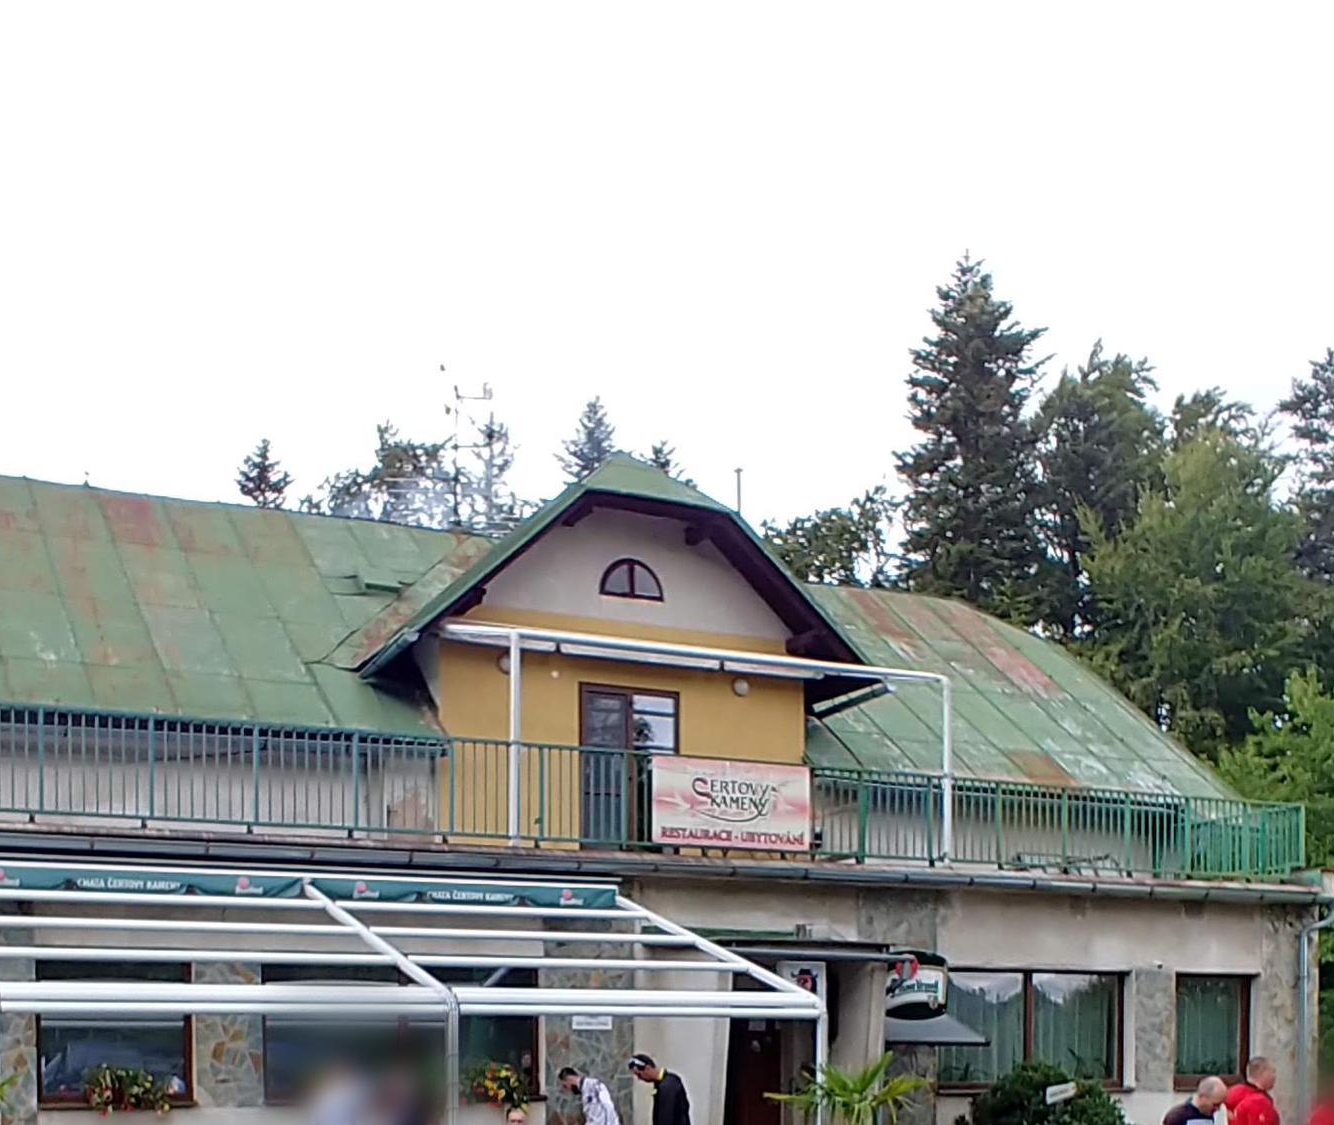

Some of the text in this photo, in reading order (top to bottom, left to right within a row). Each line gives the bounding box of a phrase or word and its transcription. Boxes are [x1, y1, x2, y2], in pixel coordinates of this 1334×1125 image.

[710, 796, 770, 817] KAMENY
[661, 827, 733, 842] RESTAURACE
[741, 831, 805, 846] UBYTOVÁNÍ
